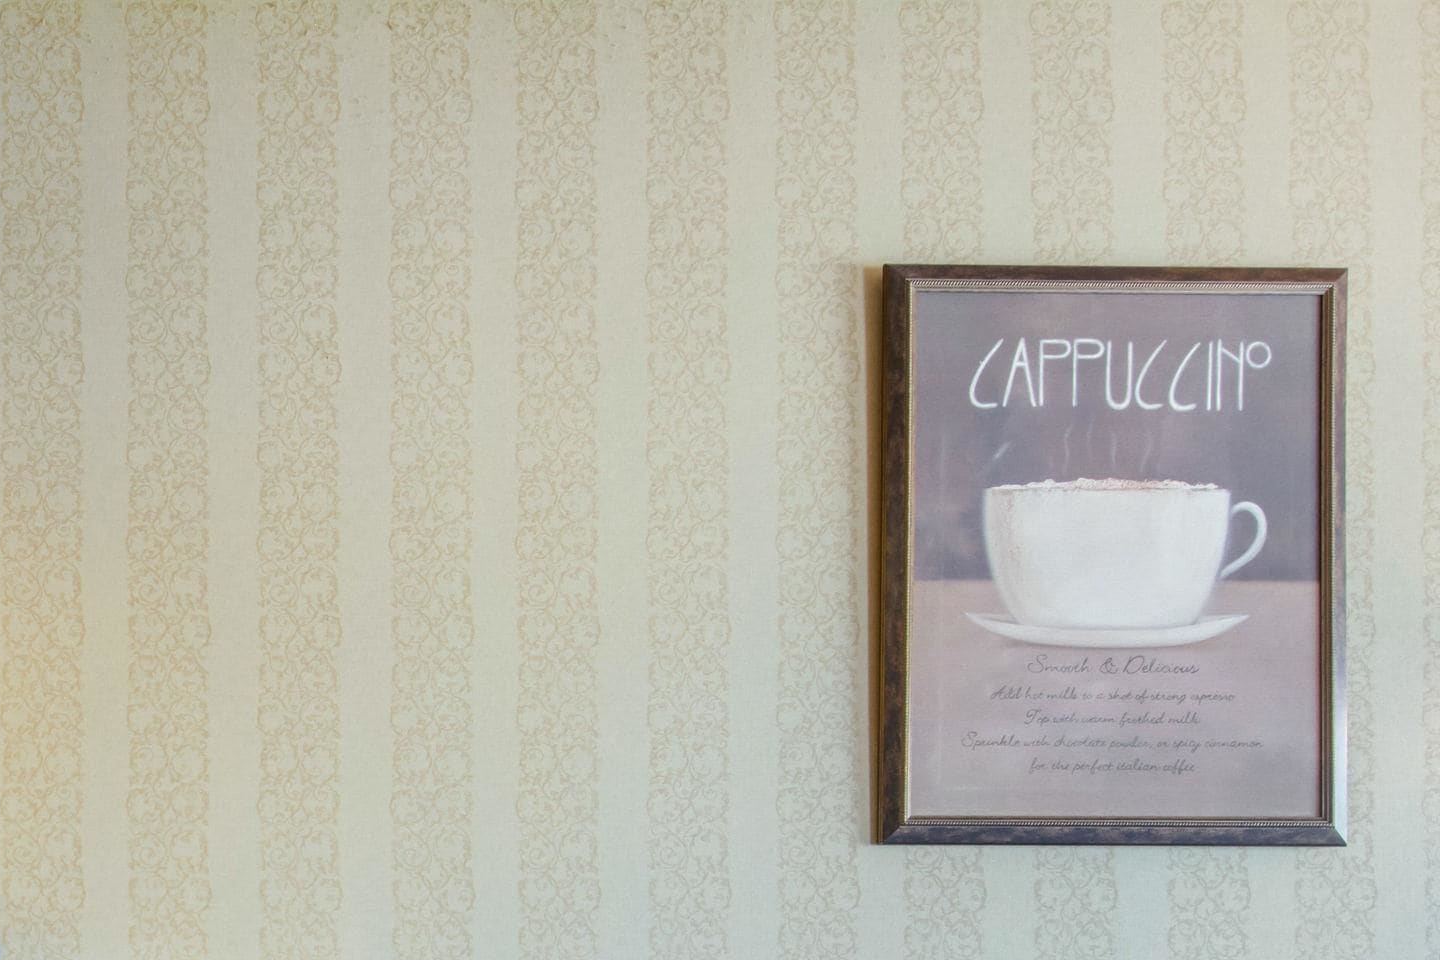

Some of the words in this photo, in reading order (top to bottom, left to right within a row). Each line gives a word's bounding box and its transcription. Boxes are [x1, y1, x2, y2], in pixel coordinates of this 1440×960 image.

[968, 337, 1273, 411] CAPPUCCINO
[1027, 654, 1092, 674] Smooth
[1100, 656, 1119, 675] &
[1123, 655, 1201, 675] Delicious
[1024, 686, 1043, 701] hot
[1107, 687, 1132, 701] shot
[1134, 689, 1151, 705] of
[1150, 692, 1187, 705] strong
[1024, 708, 1050, 726] Top
[1119, 711, 1165, 728] frothed
[960, 730, 1020, 751] Sprinkle
[1171, 738, 1201, 753] spicy
[1072, 758, 1114, 775] perfect
